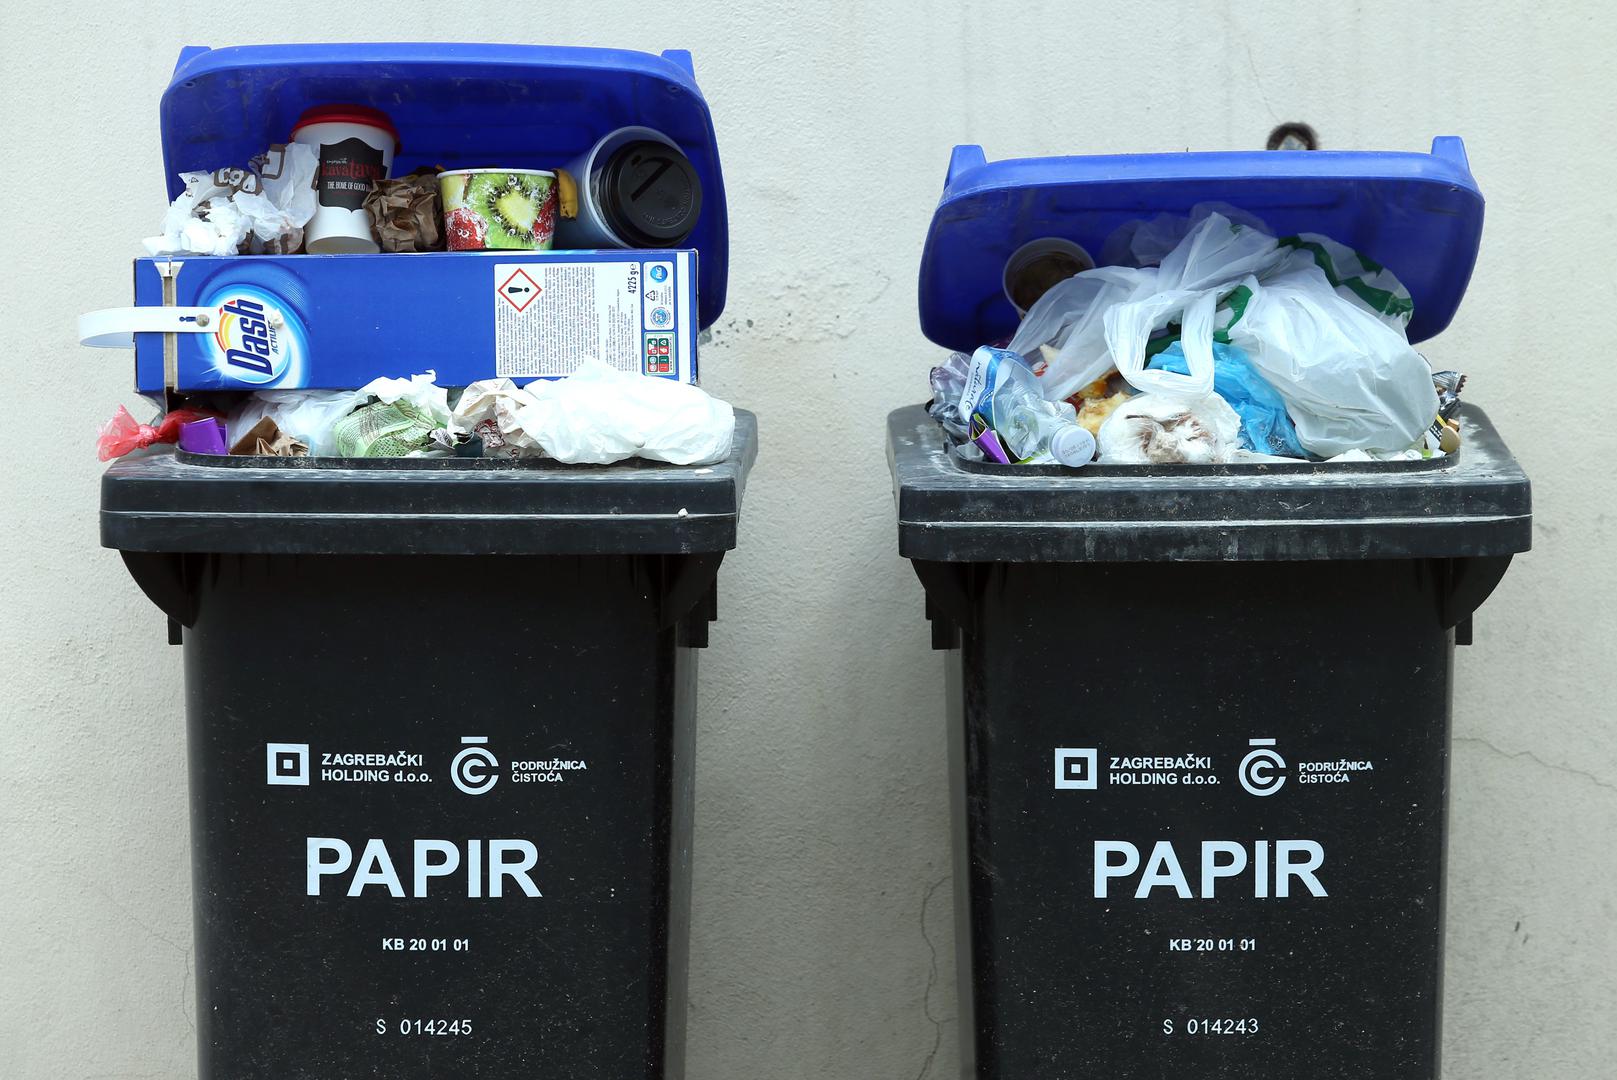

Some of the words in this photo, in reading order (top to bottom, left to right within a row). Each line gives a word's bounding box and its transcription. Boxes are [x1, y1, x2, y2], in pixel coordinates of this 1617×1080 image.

[327, 181, 336, 190] THE
[347, 182, 354, 190] OF
[628, 277, 637, 294] 4225
[224, 299, 273, 376] Dash
[321, 750, 423, 767] ZAGREBAČKI
[511, 757, 588, 771] PODRUŽNICA
[1109, 753, 1211, 769] ZAGREBAČKI
[1298, 758, 1374, 772] PODRUŽNICA
[321, 769, 390, 782] HOLDING
[393, 770, 433, 783] d.o.o.
[511, 770, 564, 783] ČISTOĆA
[1109, 772, 1178, 785] HOLDING
[1181, 772, 1221, 785] d.o.o.
[1298, 770, 1350, 784] ČISTOĆA
[306, 837, 543, 898] PAPIR
[1093, 839, 1329, 899] PAPIR
[382, 938, 405, 951] KB
[409, 938, 427, 951] 20
[431, 938, 447, 951] 01
[453, 938, 469, 951] 01
[1169, 939, 1192, 951] KB
[1196, 939, 1214, 951] 20
[1218, 939, 1234, 951] 01
[1240, 939, 1256, 951] 01
[376, 1018, 387, 1035] S
[400, 1018, 473, 1036] 014245
[1162, 1018, 1174, 1035] S
[1187, 1017, 1259, 1035] 014243
